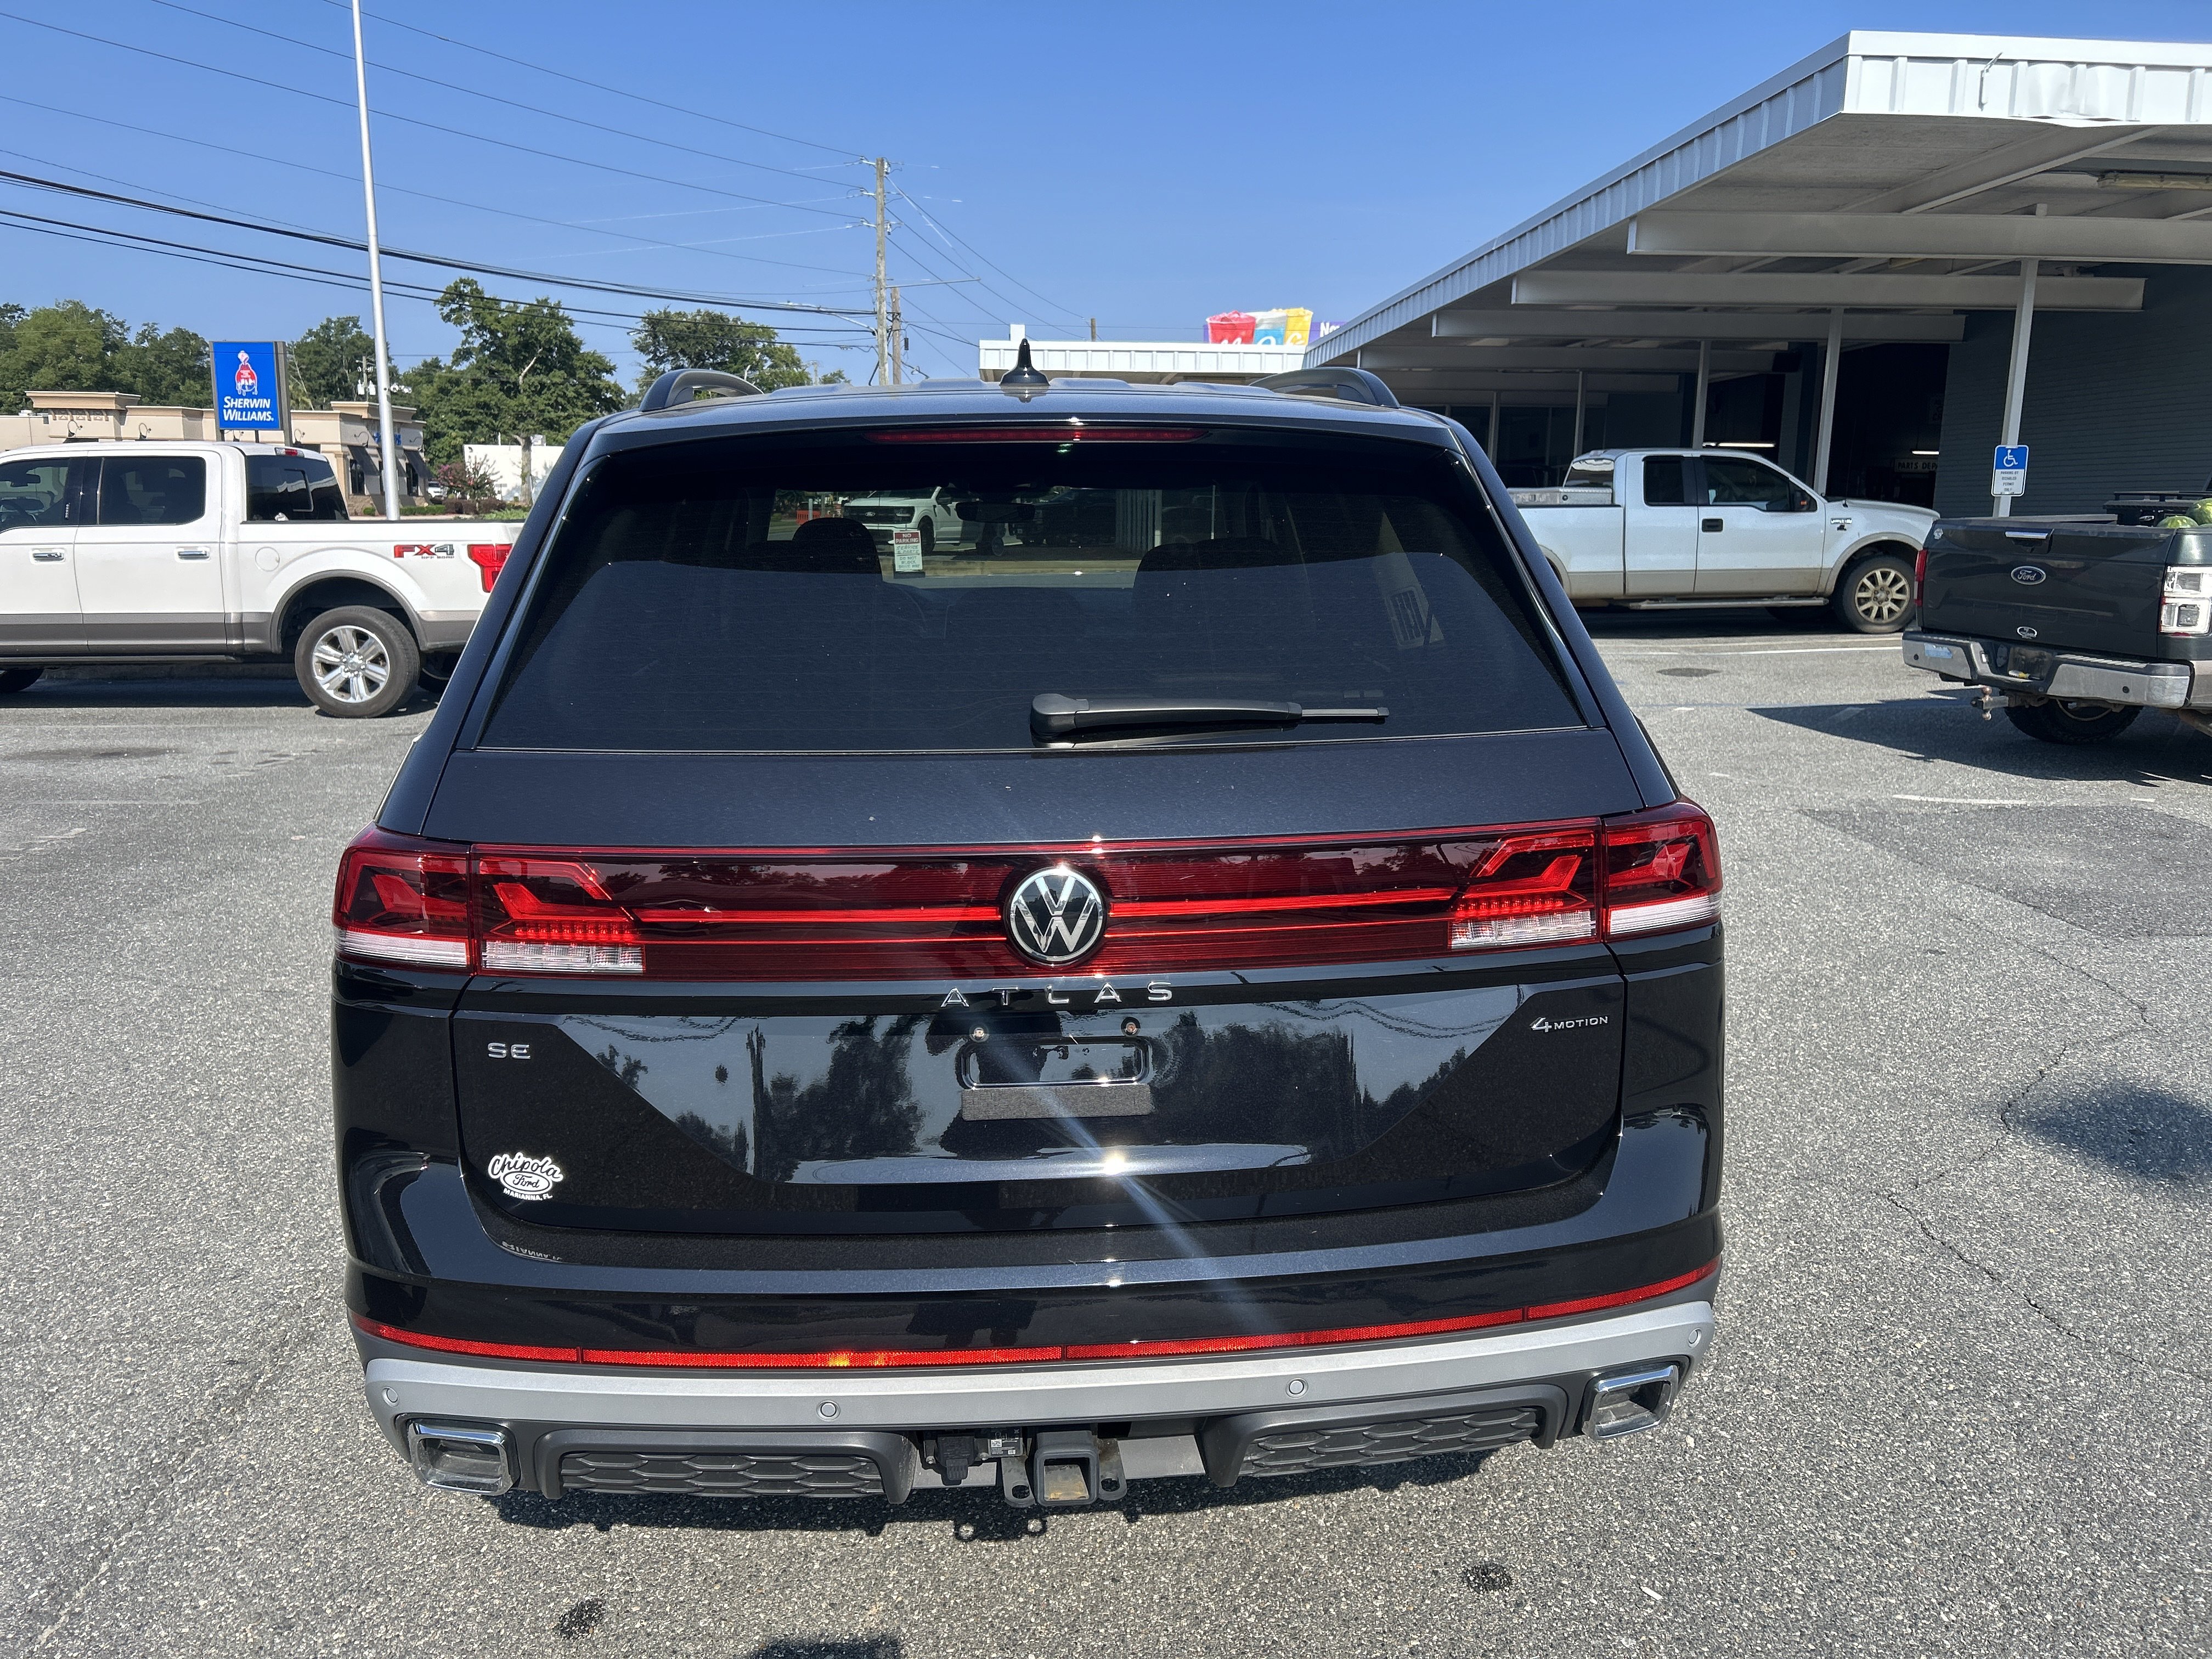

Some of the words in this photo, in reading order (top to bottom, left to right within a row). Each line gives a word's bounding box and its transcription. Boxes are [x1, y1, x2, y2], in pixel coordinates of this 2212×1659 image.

[223, 396, 270, 408] SHERWIN
[394, 544, 454, 558] FX4
[2017, 569, 2037, 580] Ford
[940, 981, 1173, 1007] ATLAS
[1529, 1016, 1608, 1033] 4MOTION
[488, 1042, 531, 1059] SE
[490, 1154, 561, 1179] Chipola
[512, 1173, 540, 1188] Ford
[503, 1188, 543, 1200] MARIANNA,
